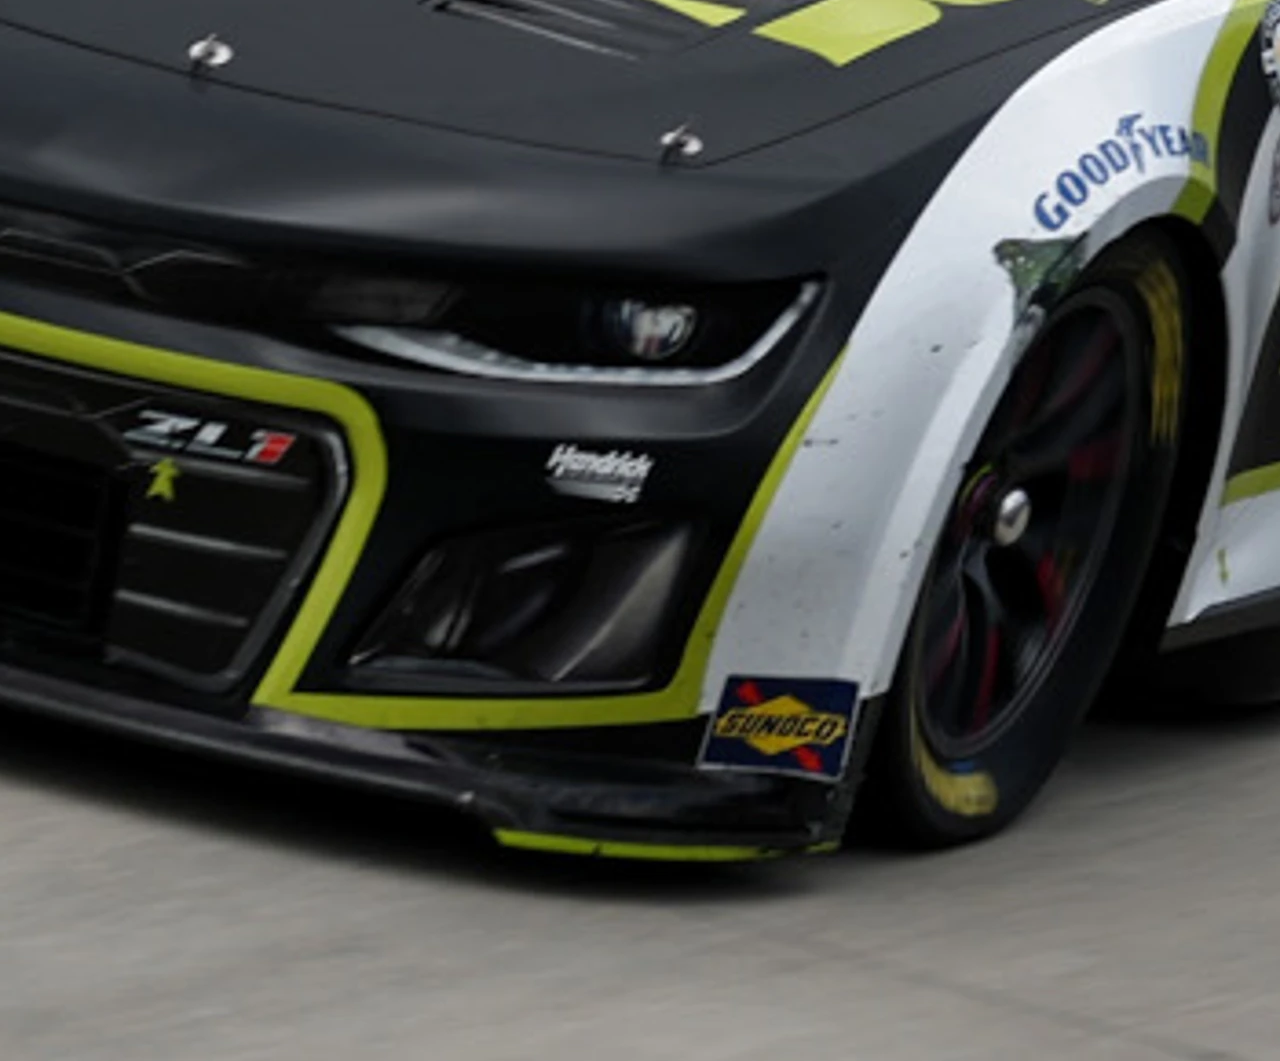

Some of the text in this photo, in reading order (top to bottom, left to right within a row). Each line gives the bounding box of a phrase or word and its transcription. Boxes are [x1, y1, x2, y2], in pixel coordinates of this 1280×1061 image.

[1033, 113, 1211, 232] GOODYEAR
[122, 409, 297, 464] ZL1
[544, 443, 655, 478] Hendrick
[723, 712, 841, 741] SUNOCO
